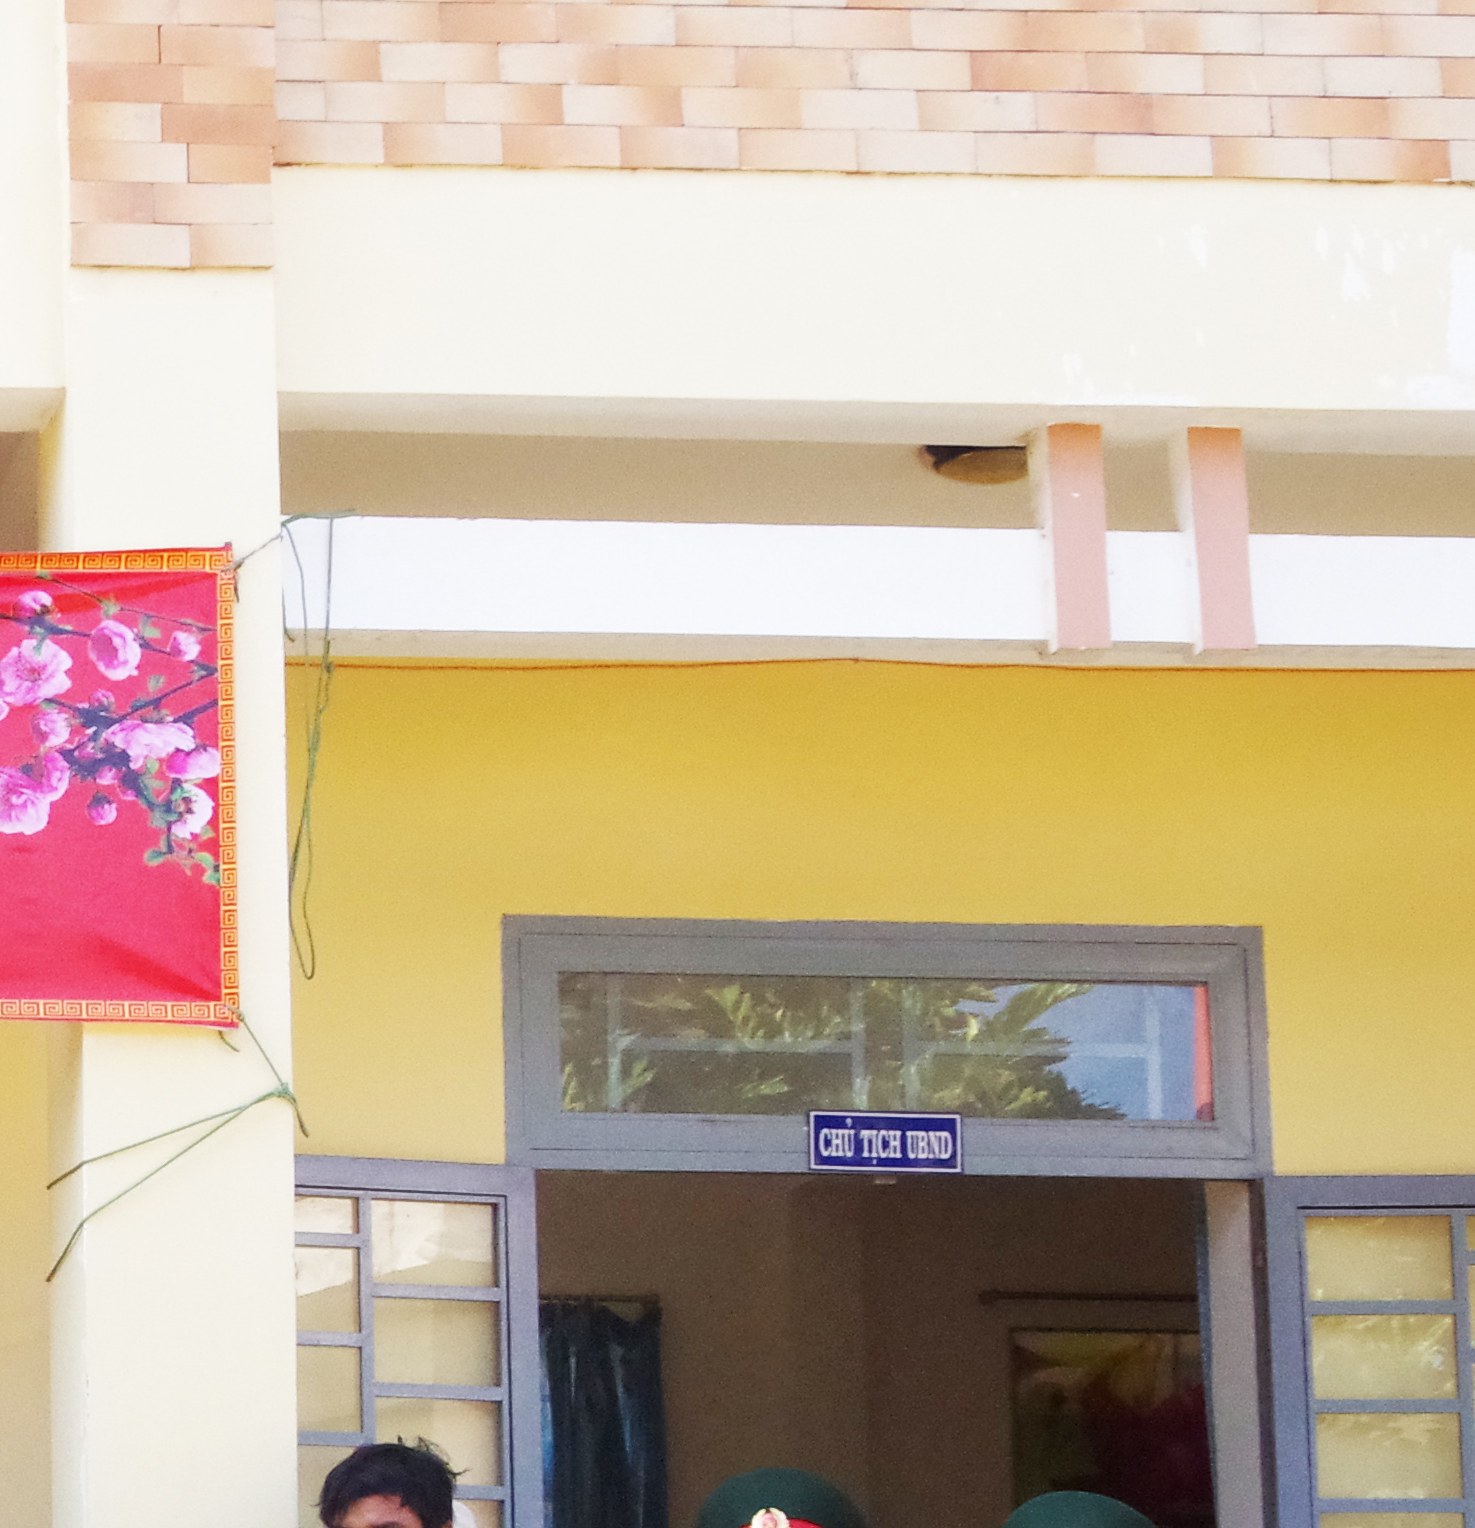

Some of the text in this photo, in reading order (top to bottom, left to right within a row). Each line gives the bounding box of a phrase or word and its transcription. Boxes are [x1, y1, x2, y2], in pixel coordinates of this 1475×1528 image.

[819, 1118, 954, 1165] CHỦ TỊCH UBND
